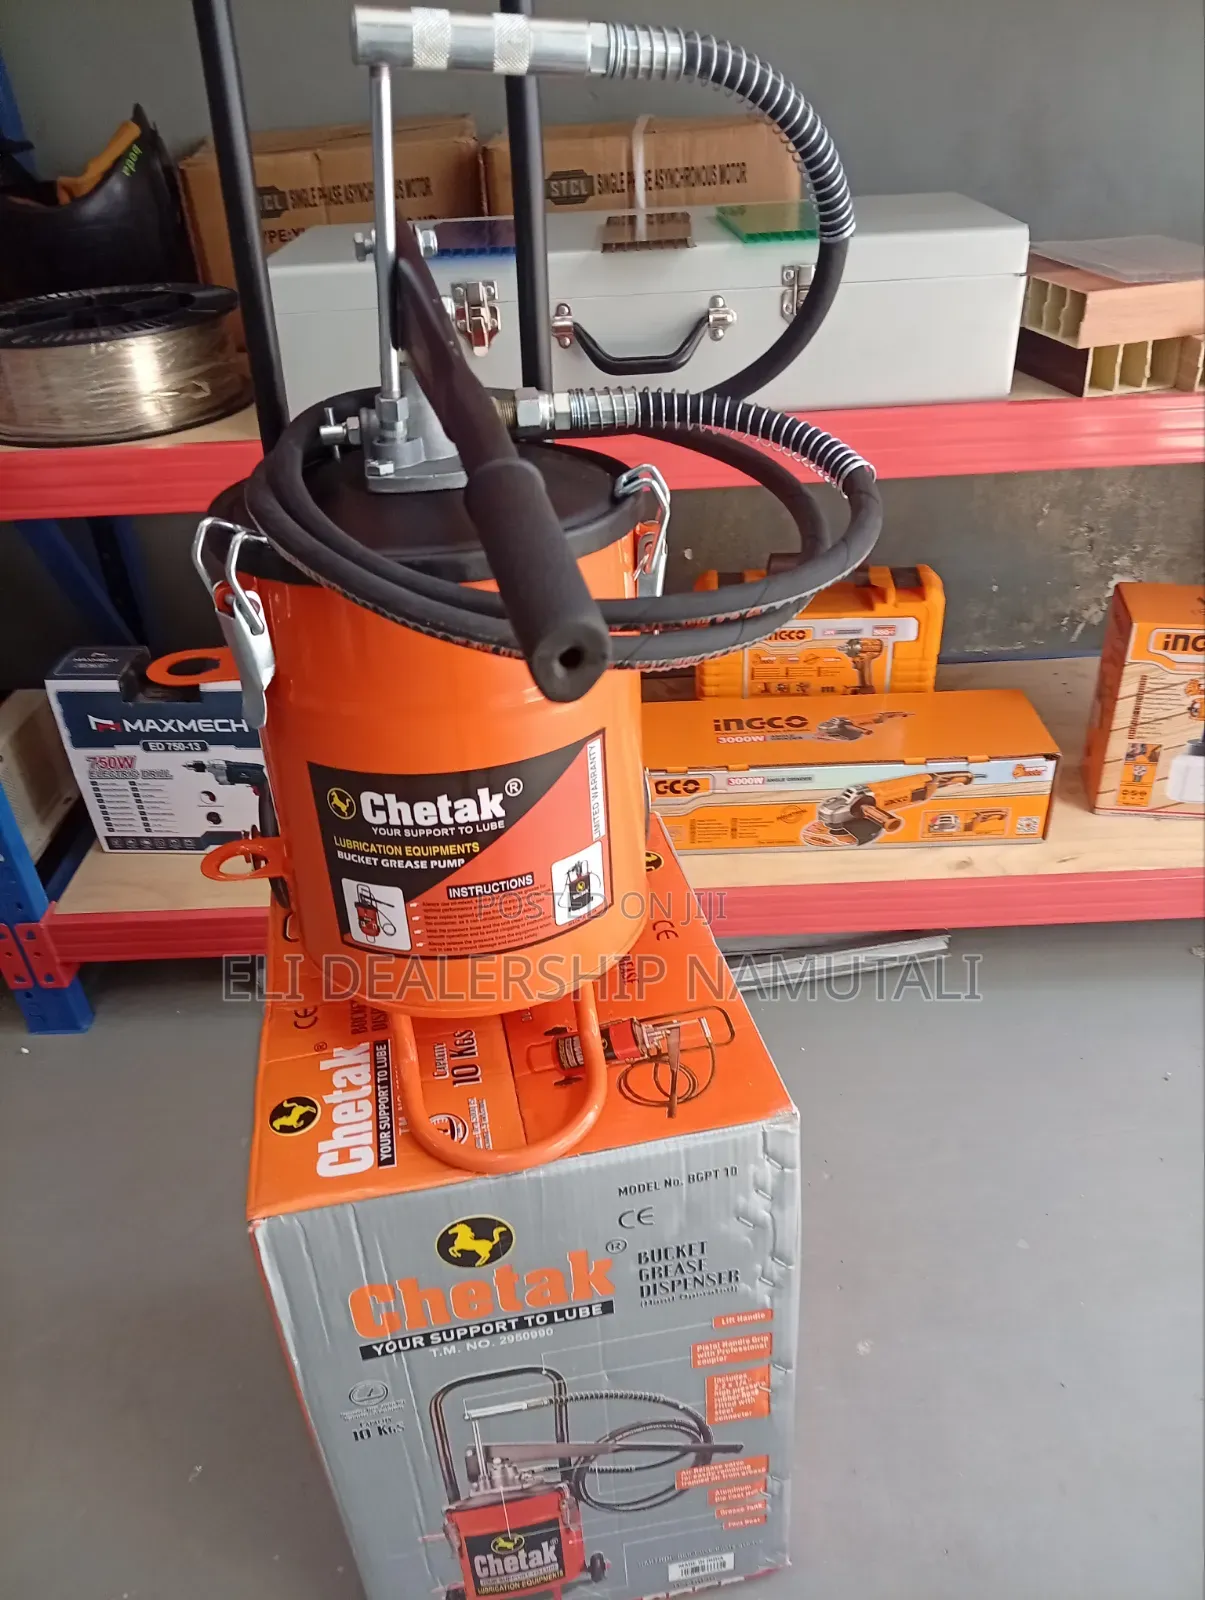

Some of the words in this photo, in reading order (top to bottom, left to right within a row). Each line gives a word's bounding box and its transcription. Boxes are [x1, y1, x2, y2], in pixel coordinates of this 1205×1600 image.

[551, 180, 589, 197] STCL
[122, 718, 250, 733] MAXMECH
[149, 742, 167, 751] ED
[167, 742, 201, 751] 750-13
[717, 735, 765, 744] 3000W
[85, 755, 137, 771] 750W
[587, 743, 599, 799] WARRANTY
[728, 777, 765, 786] 3000W
[360, 787, 507, 827] Chetak
[371, 826, 402, 838] YOUR
[403, 826, 454, 838] SUPPORT
[457, 824, 474, 835] TO
[475, 820, 506, 834] LUBE
[592, 799, 602, 841] LIMITED
[333, 835, 403, 857] LUBRICATION
[404, 842, 480, 857] EQUIPMENTS
[336, 850, 379, 868] BUCKET
[381, 858, 429, 870] GREASE
[430, 857, 466, 870] PUMP
[448, 874, 534, 899] INSTRUCTIONS
[375, 1043, 388, 1067] LUBE
[376, 1069, 388, 1085] TO
[452, 1062, 483, 1088] 10
[316, 1041, 375, 1179] Chetak
[377, 1085, 391, 1131] SUPPORT
[379, 1130, 393, 1162] YOUR
[618, 1182, 661, 1198] MODEL
[663, 1177, 684, 1189] No.
[688, 1169, 721, 1184] BGPT
[724, 1166, 738, 1178] 10
[638, 1241, 708, 1265] BUCKET
[639, 1259, 708, 1282] GREASE
[348, 1248, 616, 1340] Chetak
[640, 1269, 740, 1299] DISPENSER
[372, 1335, 425, 1357] YOUR
[429, 1317, 519, 1346] SUPPORT
[523, 1313, 548, 1327] TO
[553, 1303, 604, 1323] LUBE
[429, 1344, 462, 1359] T.M.
[466, 1339, 496, 1352] NO.
[352, 1428, 371, 1442] 10
[473, 1540, 558, 1579] Chetak
